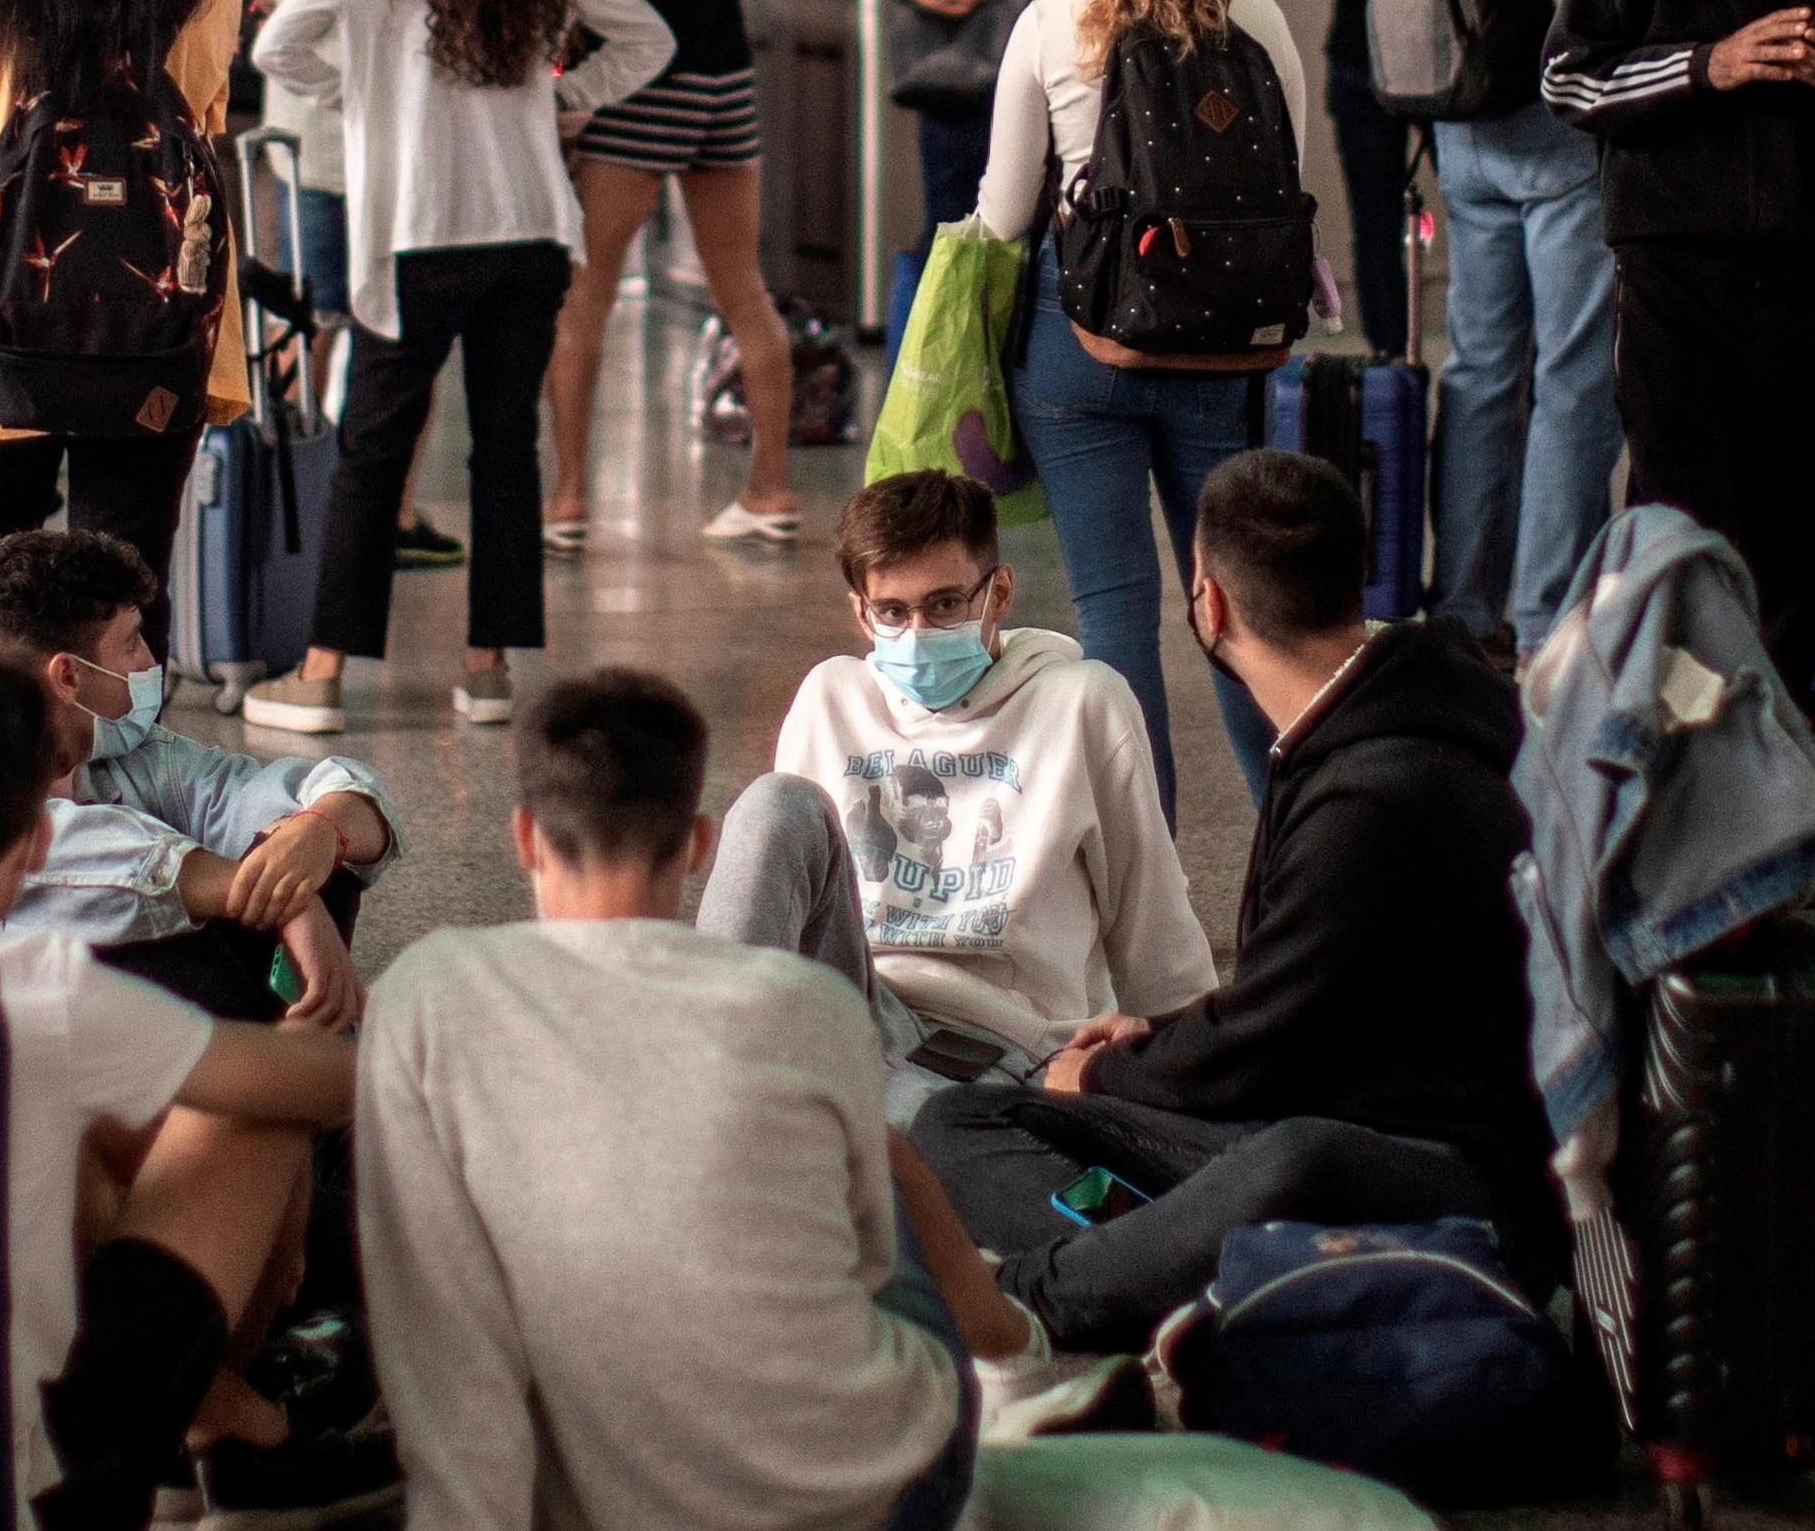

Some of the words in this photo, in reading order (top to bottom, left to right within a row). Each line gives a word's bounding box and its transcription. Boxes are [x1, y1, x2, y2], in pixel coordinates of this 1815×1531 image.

[886, 904, 954, 929] WITH
[958, 900, 1009, 936] YOU
[880, 922, 946, 948] WITH
